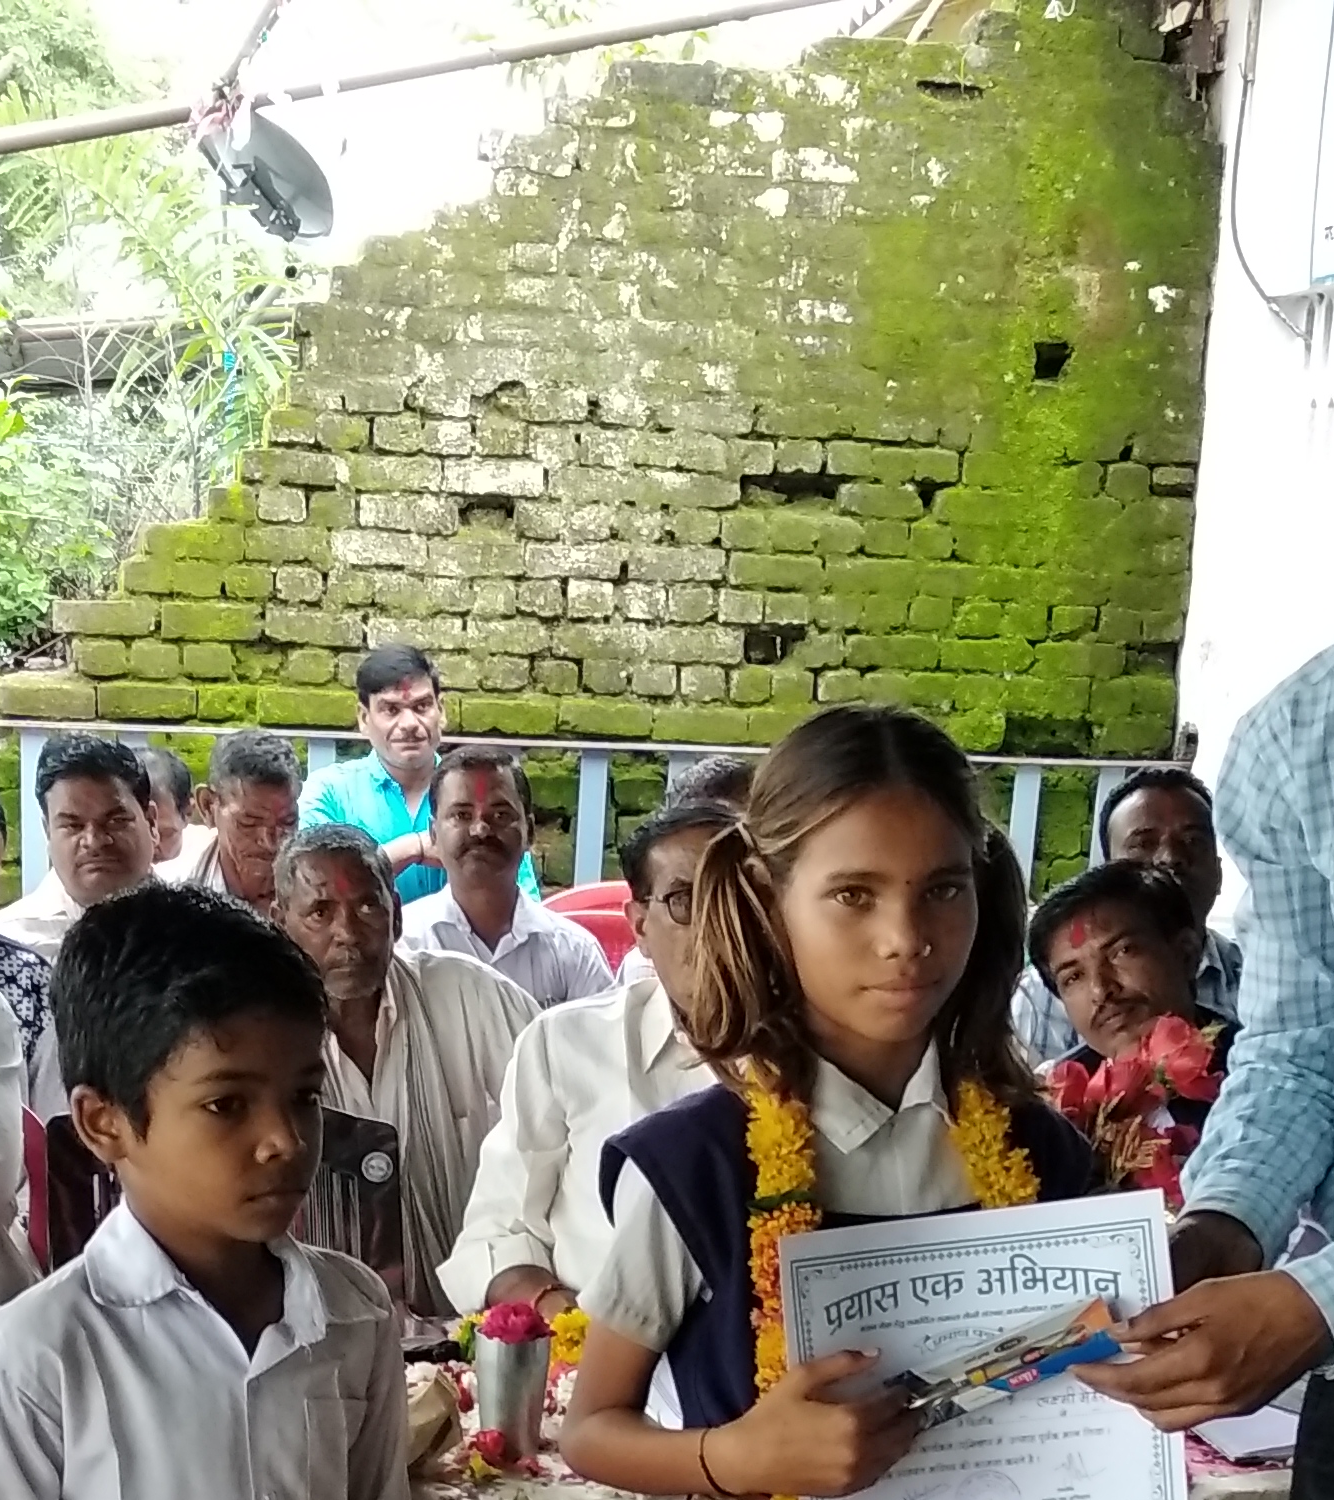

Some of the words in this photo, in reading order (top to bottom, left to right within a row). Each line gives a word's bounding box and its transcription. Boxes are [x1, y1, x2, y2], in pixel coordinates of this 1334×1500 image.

[823, 1280, 901, 1336] प्रयास
[909, 1269, 966, 1307] एक
[976, 1252, 1123, 1300] अभियान
